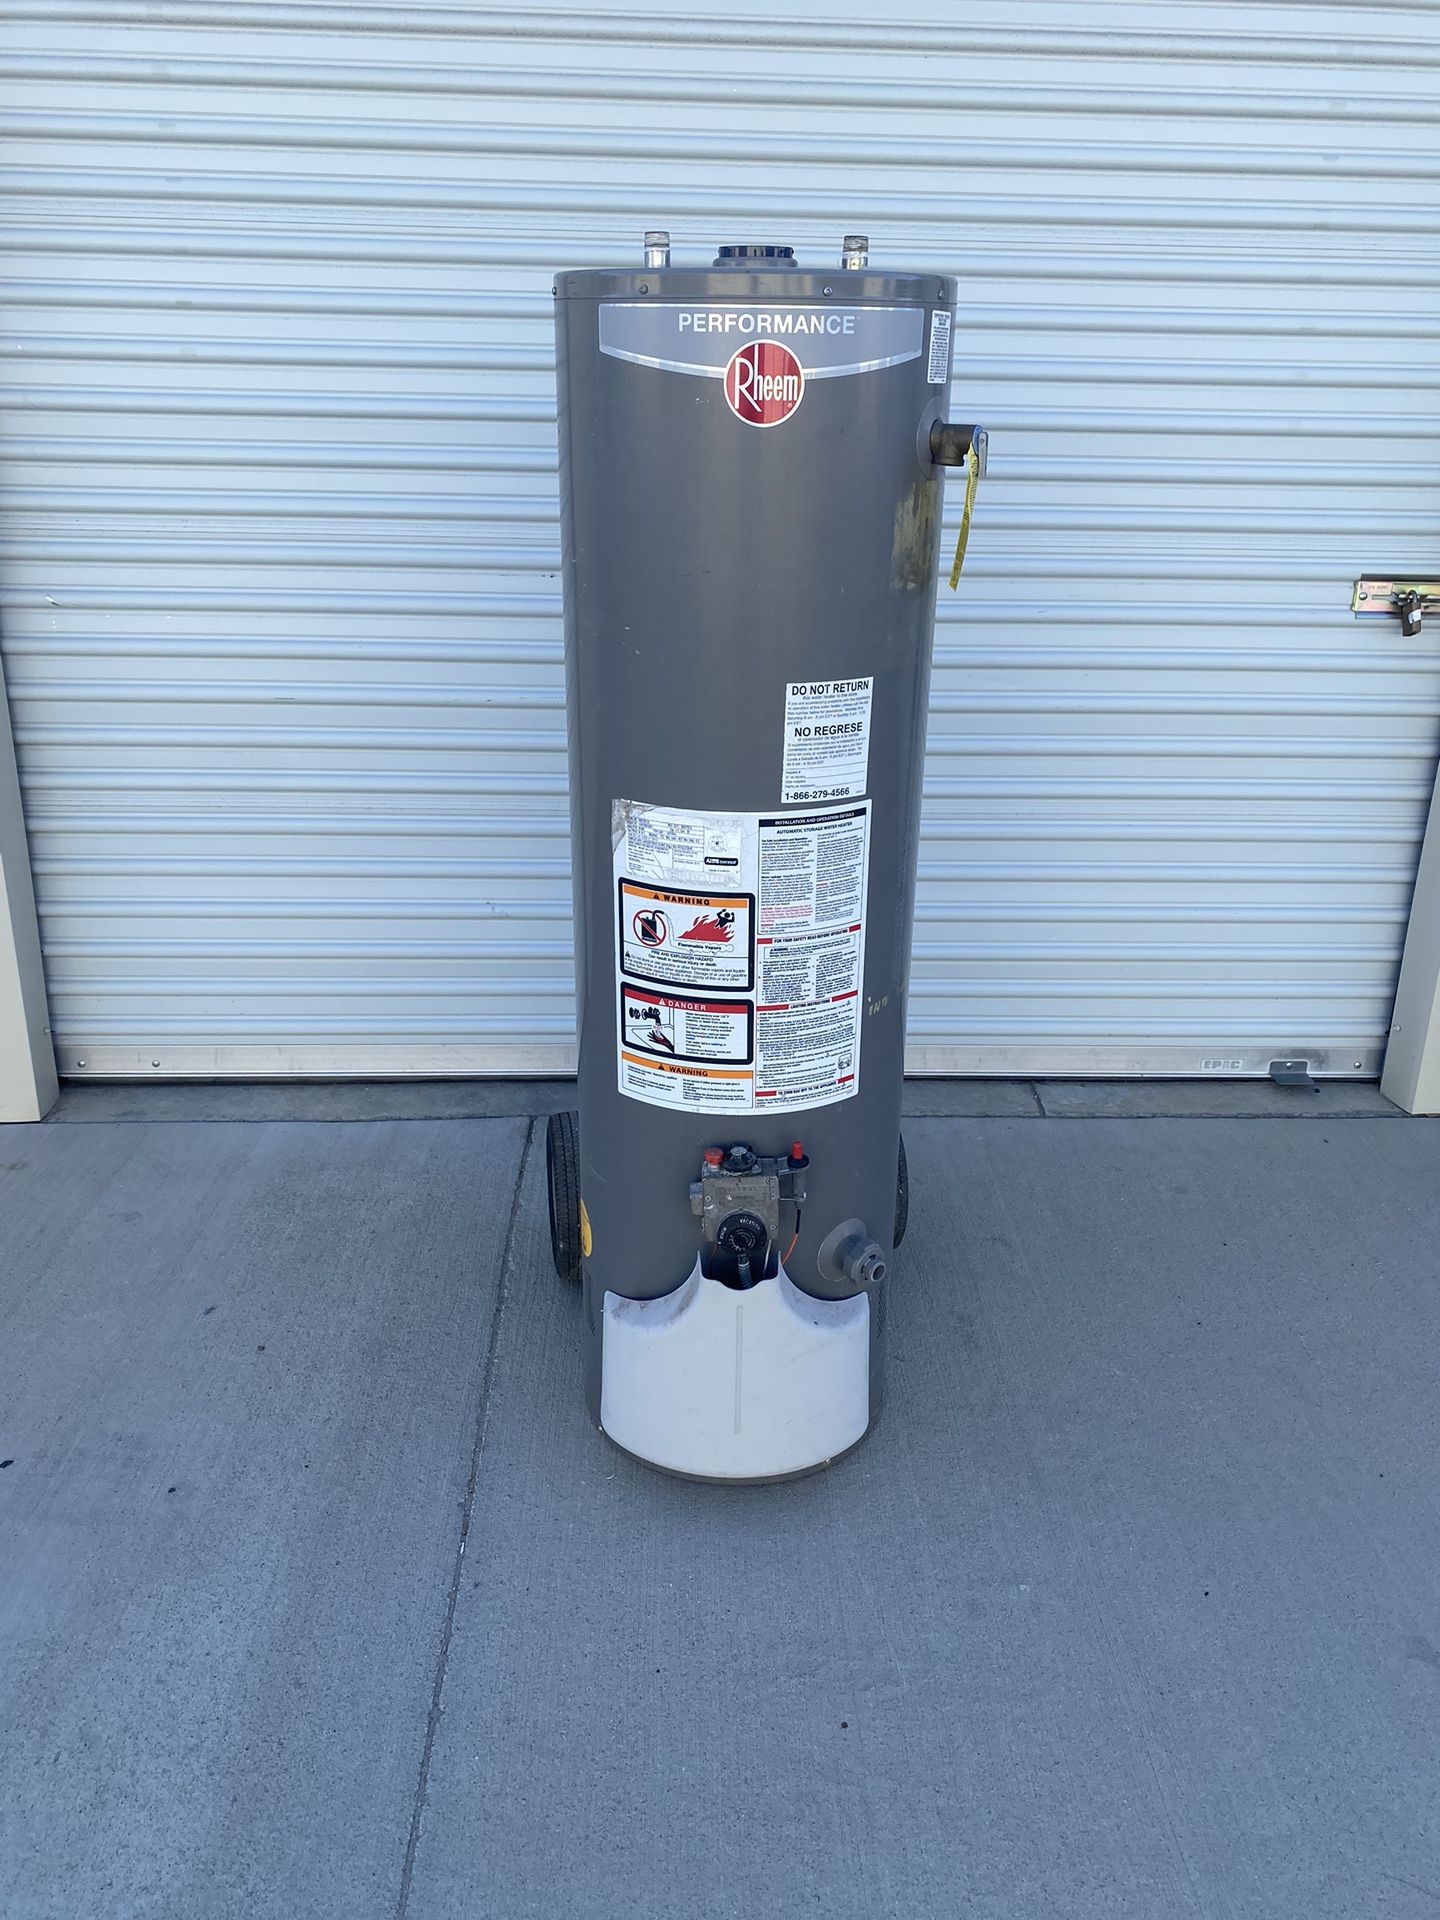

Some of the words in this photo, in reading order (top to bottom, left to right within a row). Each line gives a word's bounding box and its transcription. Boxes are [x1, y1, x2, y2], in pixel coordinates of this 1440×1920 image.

[678, 313, 855, 334] PERFORMANCE
[734, 343, 798, 412] Rheem
[791, 685, 807, 696] DO
[810, 684, 830, 695] NOT
[833, 680, 869, 693] RETURN
[794, 727, 811, 737] NO
[814, 722, 863, 736] REGRESE
[785, 787, 850, 800] 1-866-279-4566
[817, 814, 839, 822] OPERATION
[839, 811, 855, 819] DETAILS
[663, 895, 710, 906] WARNING
[668, 1000, 707, 1011] DANGER
[669, 1066, 708, 1077] WARNING
